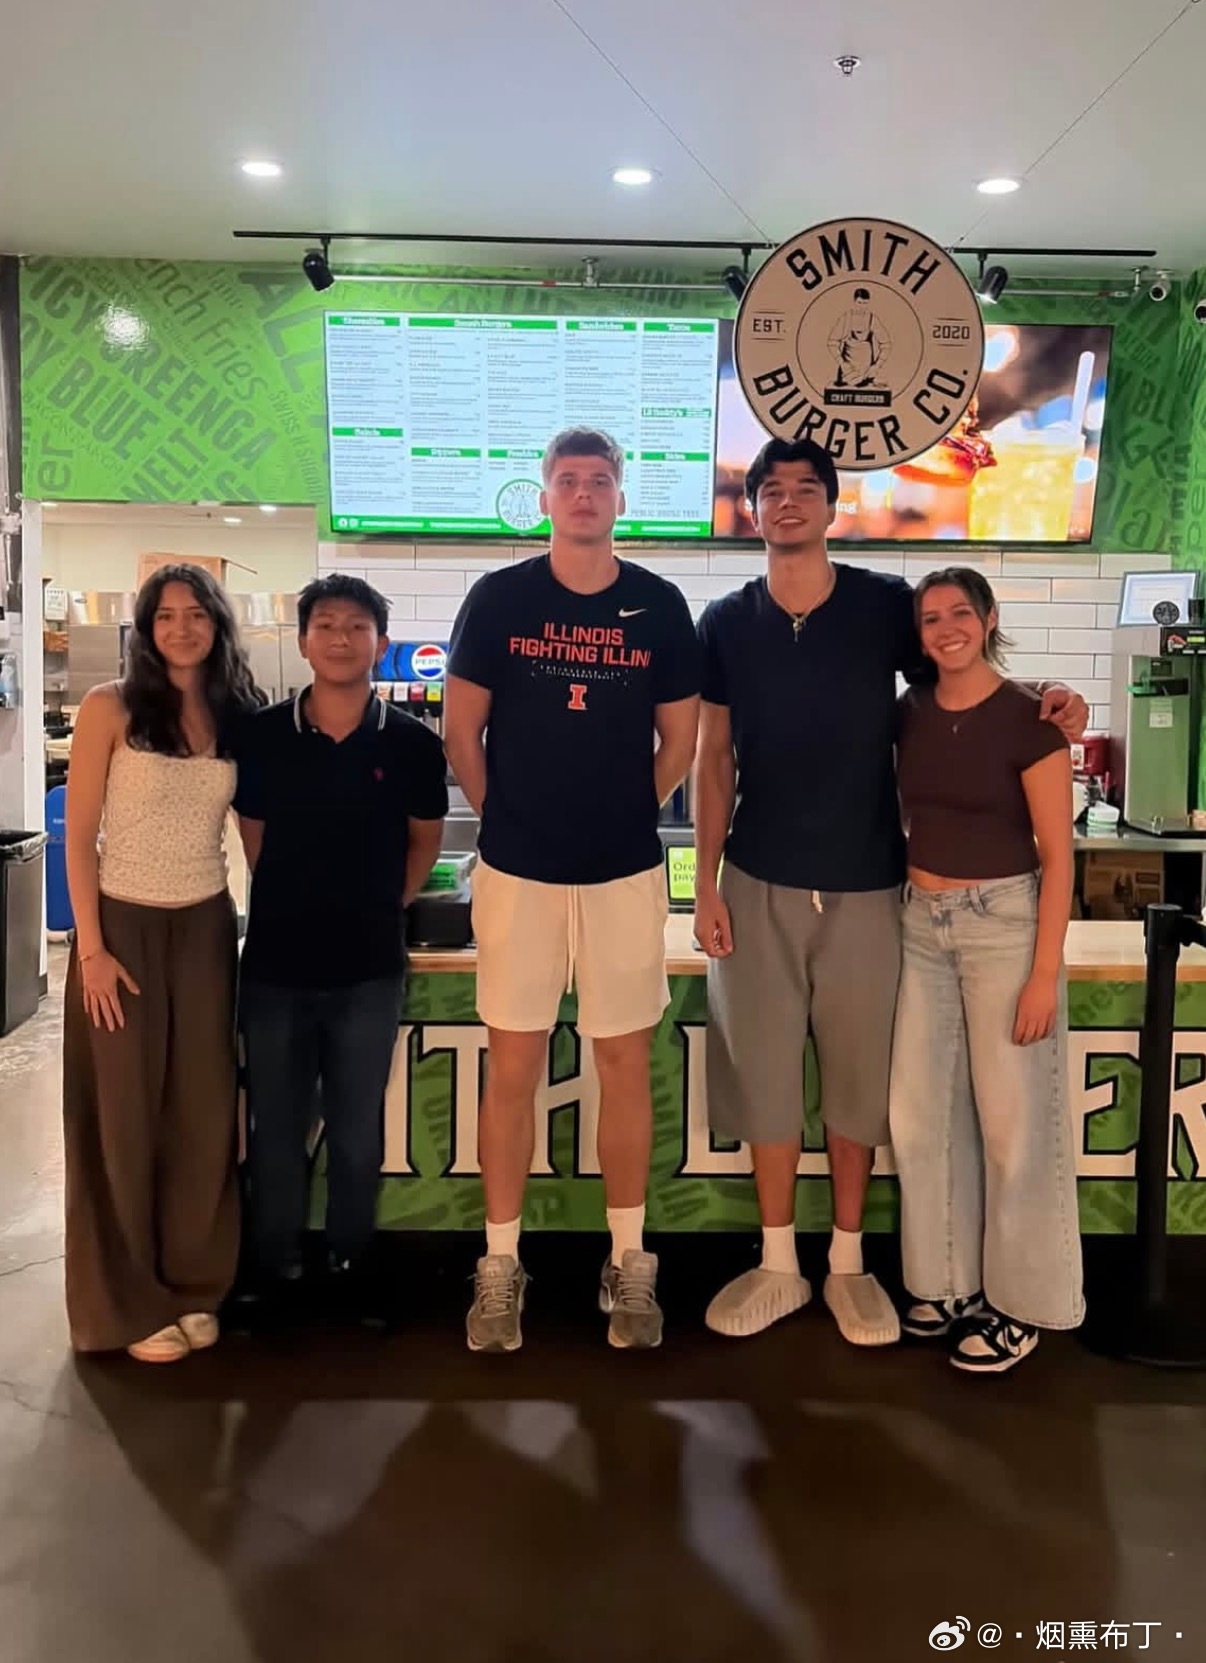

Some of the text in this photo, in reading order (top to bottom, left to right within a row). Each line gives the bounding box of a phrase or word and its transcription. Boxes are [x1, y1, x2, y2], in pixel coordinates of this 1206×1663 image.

[786, 229, 942, 295] SMITH
[752, 318, 786, 333] EST.
[932, 325, 970, 340] 2020
[47, 355, 160, 460] BLUE
[752, 363, 909, 462] BURGER
[912, 368, 969, 425] CO.
[543, 622, 624, 646] ILLINOIS
[509, 637, 597, 663] FIGHTING
